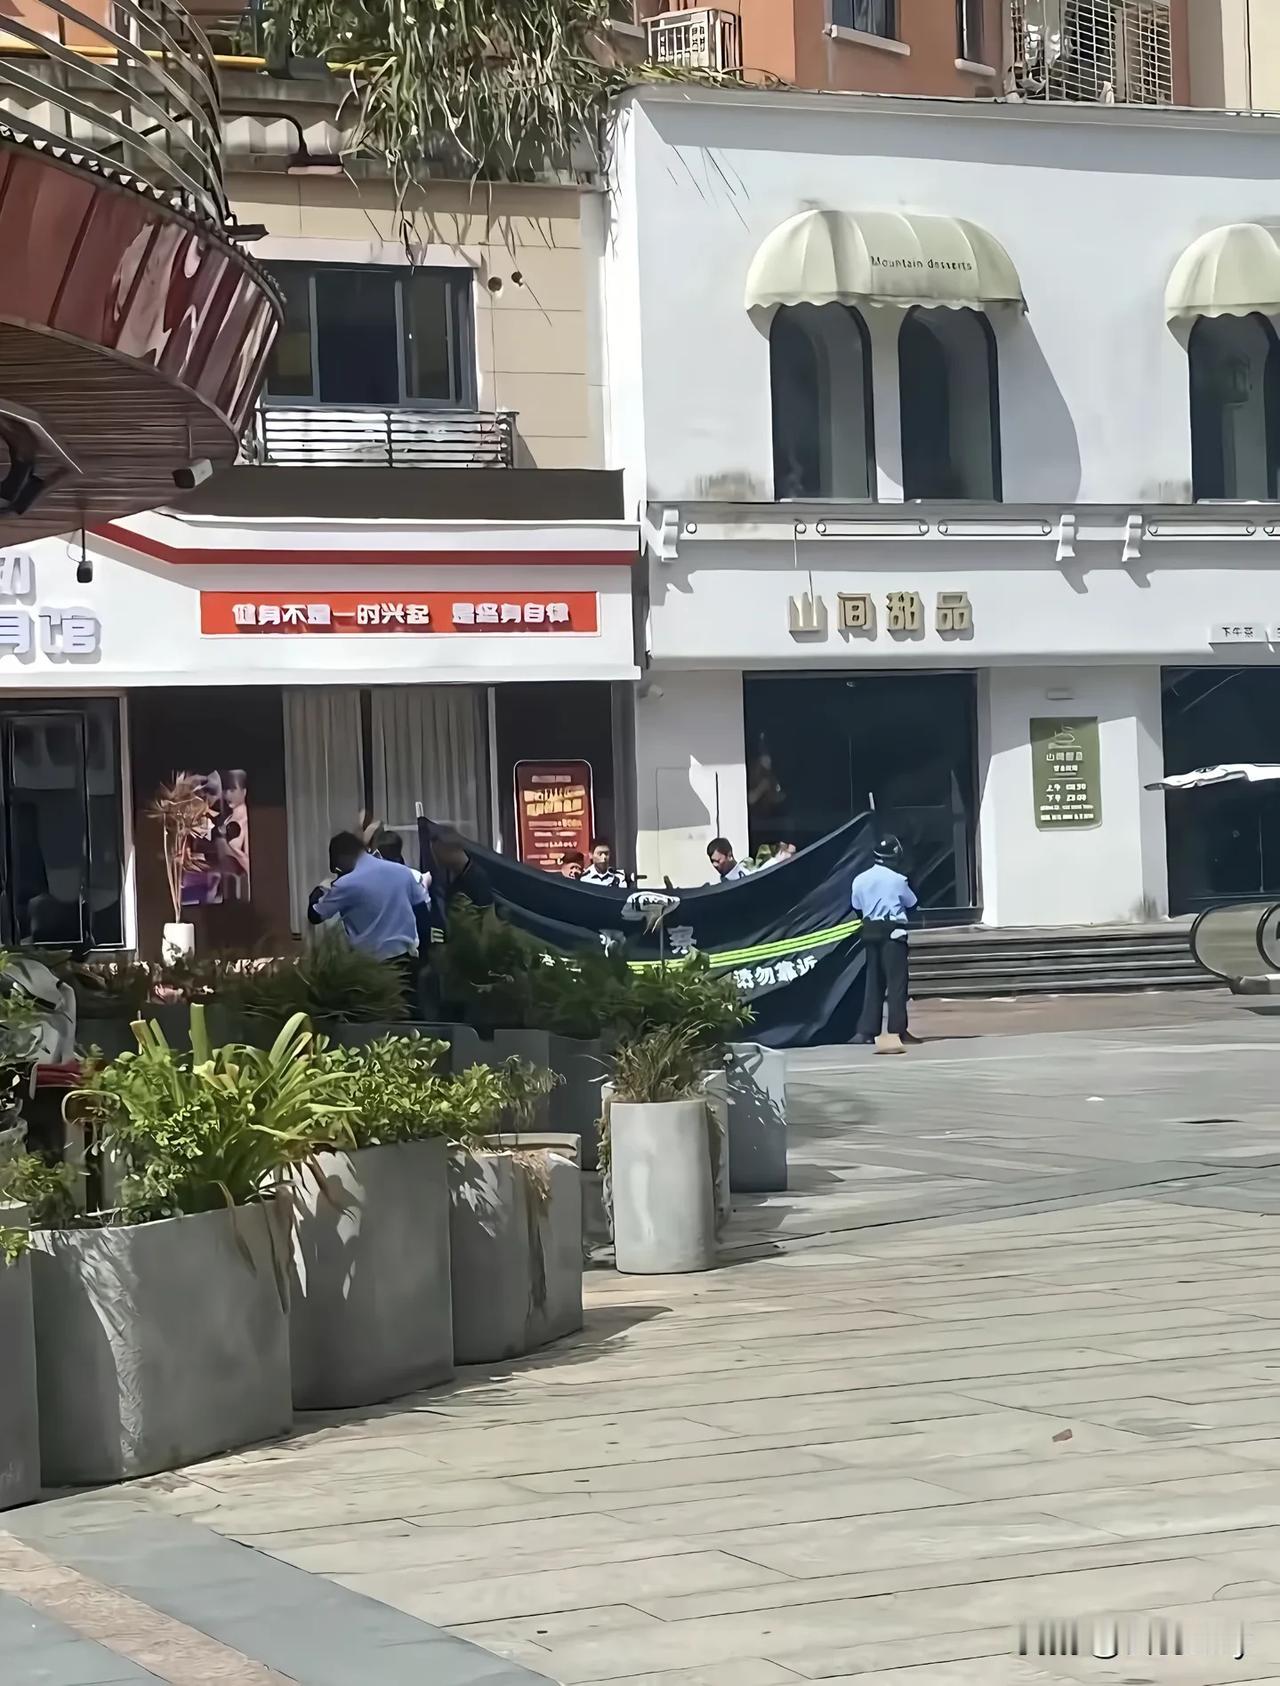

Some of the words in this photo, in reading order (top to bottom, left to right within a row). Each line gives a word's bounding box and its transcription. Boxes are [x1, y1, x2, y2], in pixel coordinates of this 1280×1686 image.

[870, 255, 923, 269] Mountain
[232, 603, 430, 625] 健身不是一时兴起
[789, 591, 968, 632] 山间甜品
[733, 955, 818, 989] 请勿靠近
